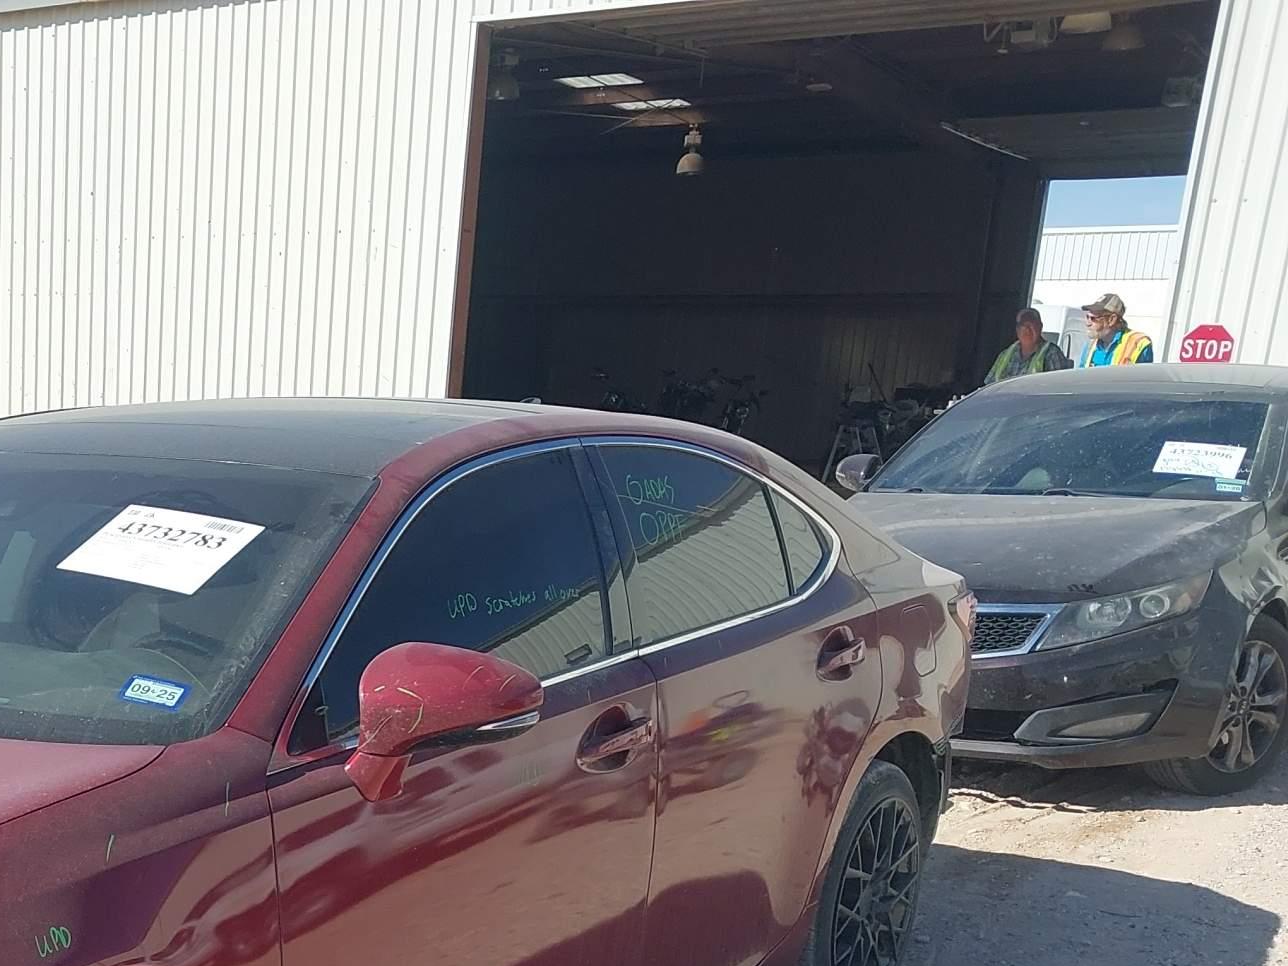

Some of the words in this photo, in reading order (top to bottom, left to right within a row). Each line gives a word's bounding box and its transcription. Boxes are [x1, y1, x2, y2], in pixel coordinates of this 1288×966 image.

[1182, 339, 1232, 360] STOP
[118, 522, 227, 549] 43732783
[35, 926, 71, 957] UPD
